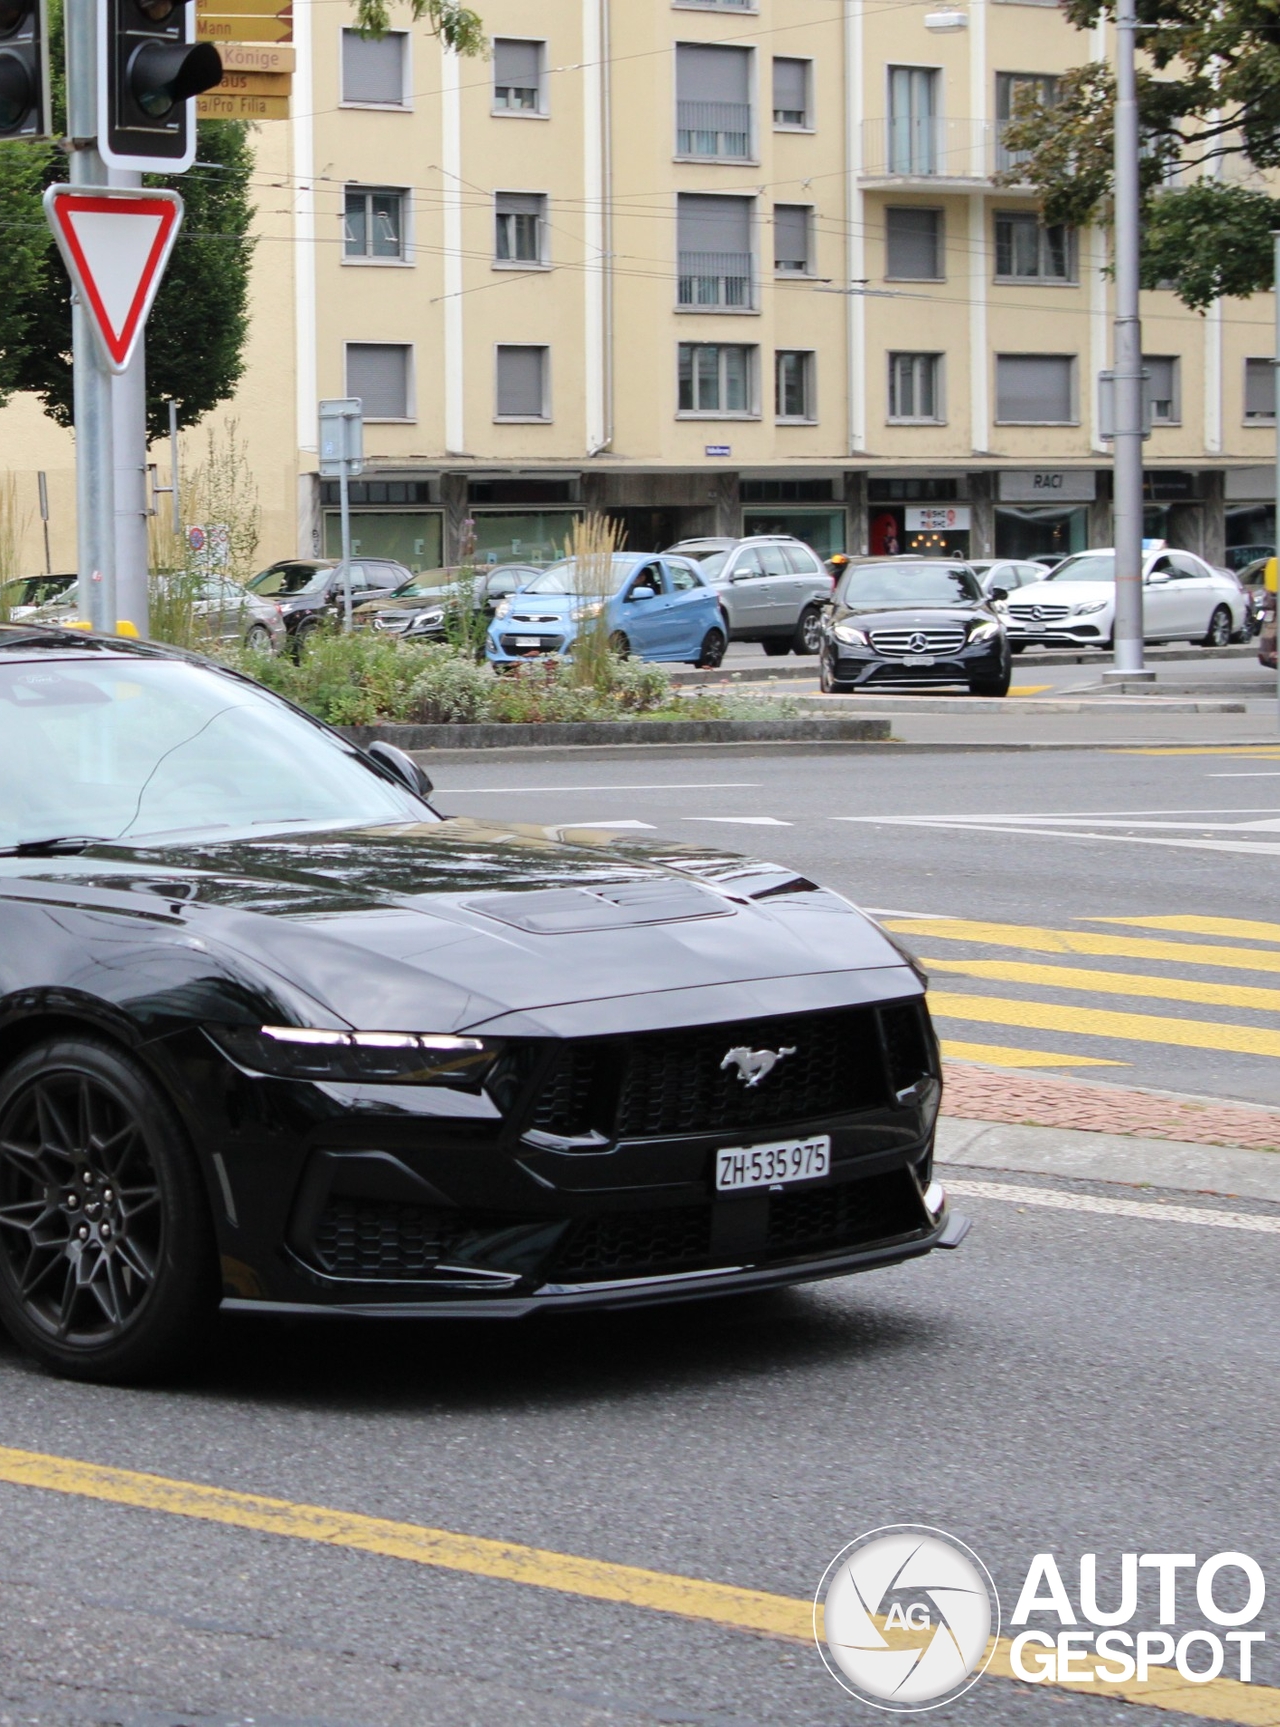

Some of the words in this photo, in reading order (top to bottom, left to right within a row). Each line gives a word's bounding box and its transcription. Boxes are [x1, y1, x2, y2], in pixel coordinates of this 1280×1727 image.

[224, 48, 280, 69] Könige
[240, 97, 266, 113] Filia
[1033, 474, 1063, 489] RACI
